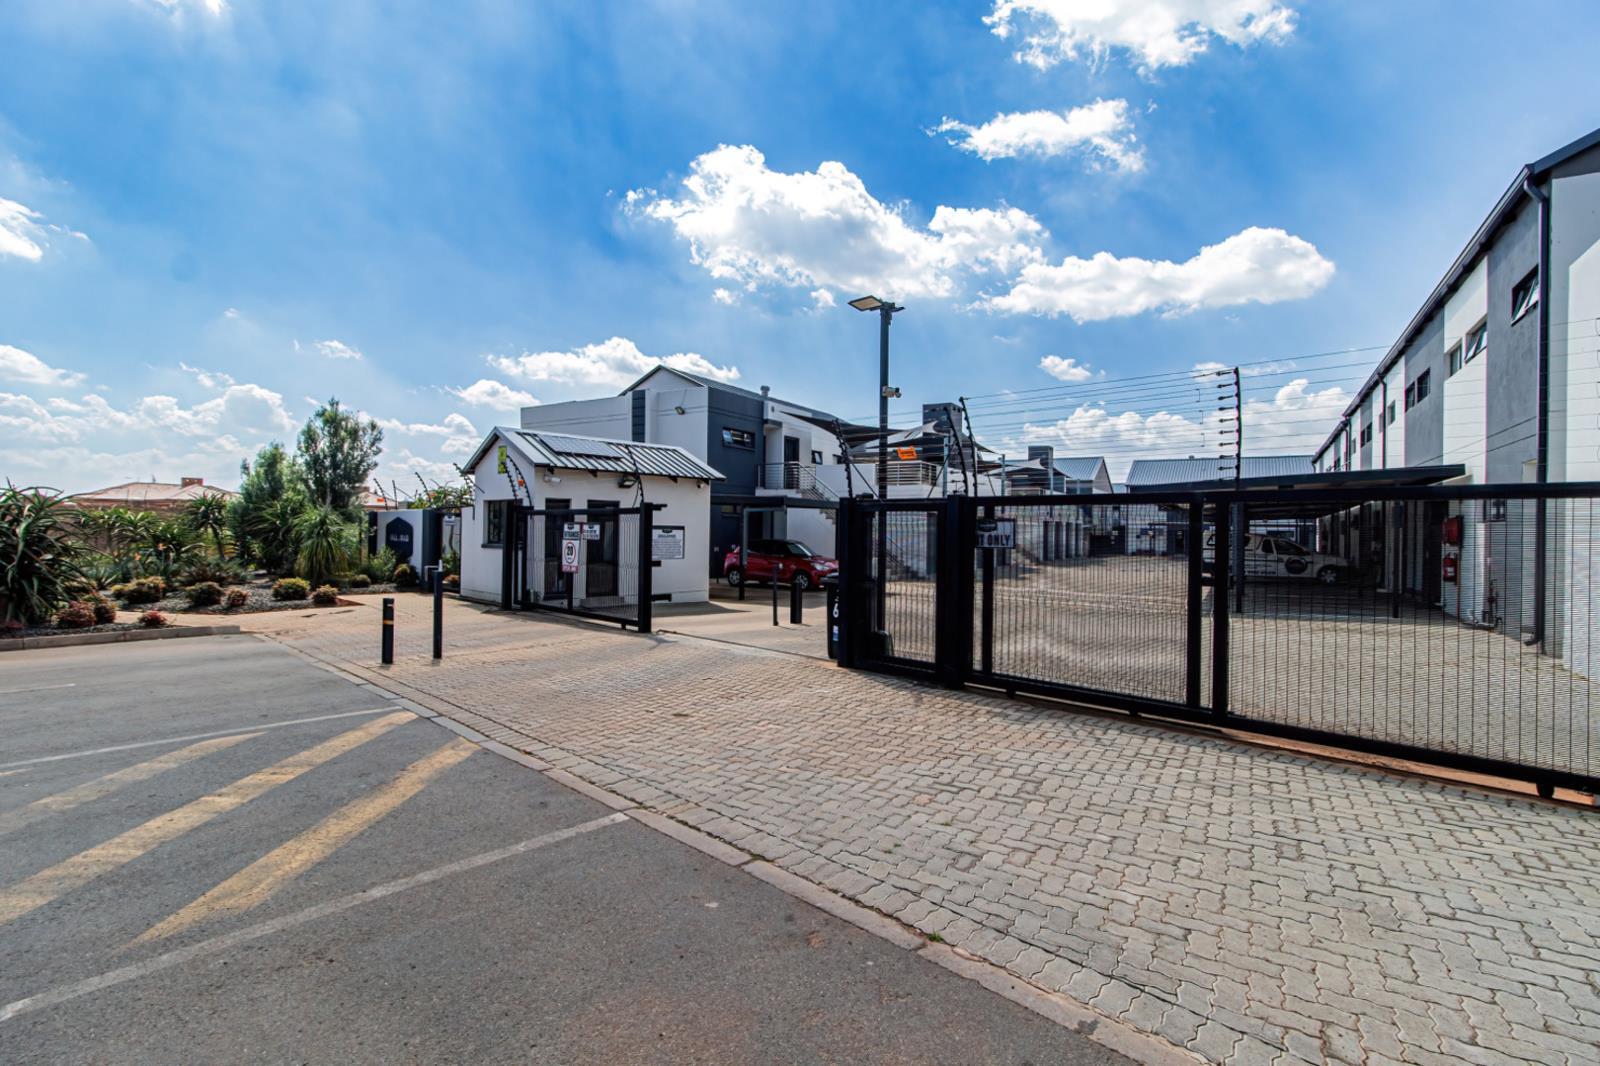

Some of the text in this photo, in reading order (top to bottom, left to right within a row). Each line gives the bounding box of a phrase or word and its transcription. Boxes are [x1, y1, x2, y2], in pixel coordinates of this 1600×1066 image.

[987, 534, 1011, 546] ONLY
[566, 545, 574, 556] 20
[832, 603, 839, 618] 6
